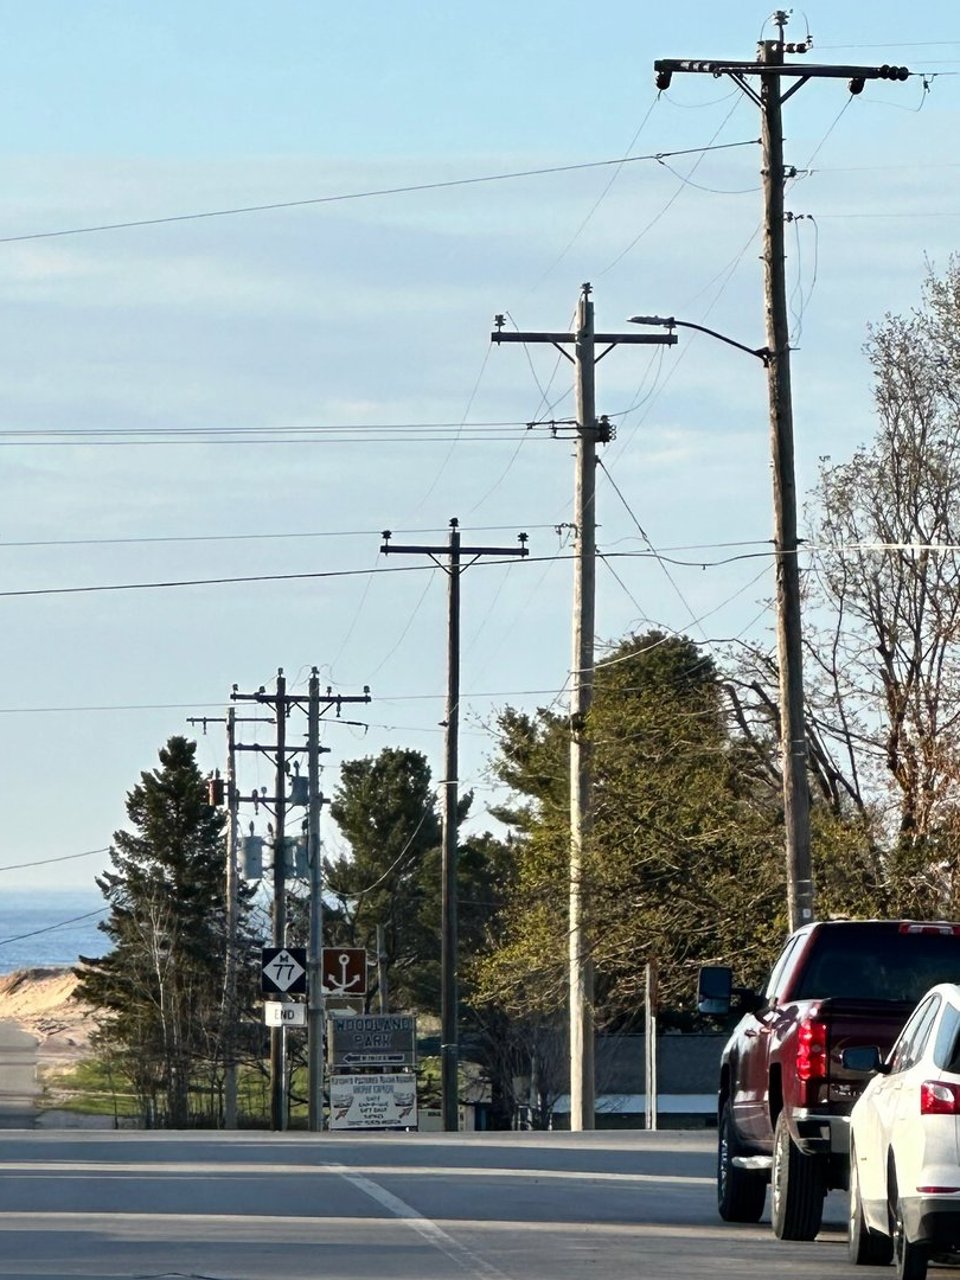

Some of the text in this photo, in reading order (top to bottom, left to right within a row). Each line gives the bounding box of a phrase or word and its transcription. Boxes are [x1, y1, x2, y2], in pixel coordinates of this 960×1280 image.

[280, 954, 289, 963] M
[273, 964, 295, 981] 77
[274, 1008, 295, 1020] END
[336, 1017, 410, 1032] WOODLAND
[353, 1033, 392, 1049] PARK
